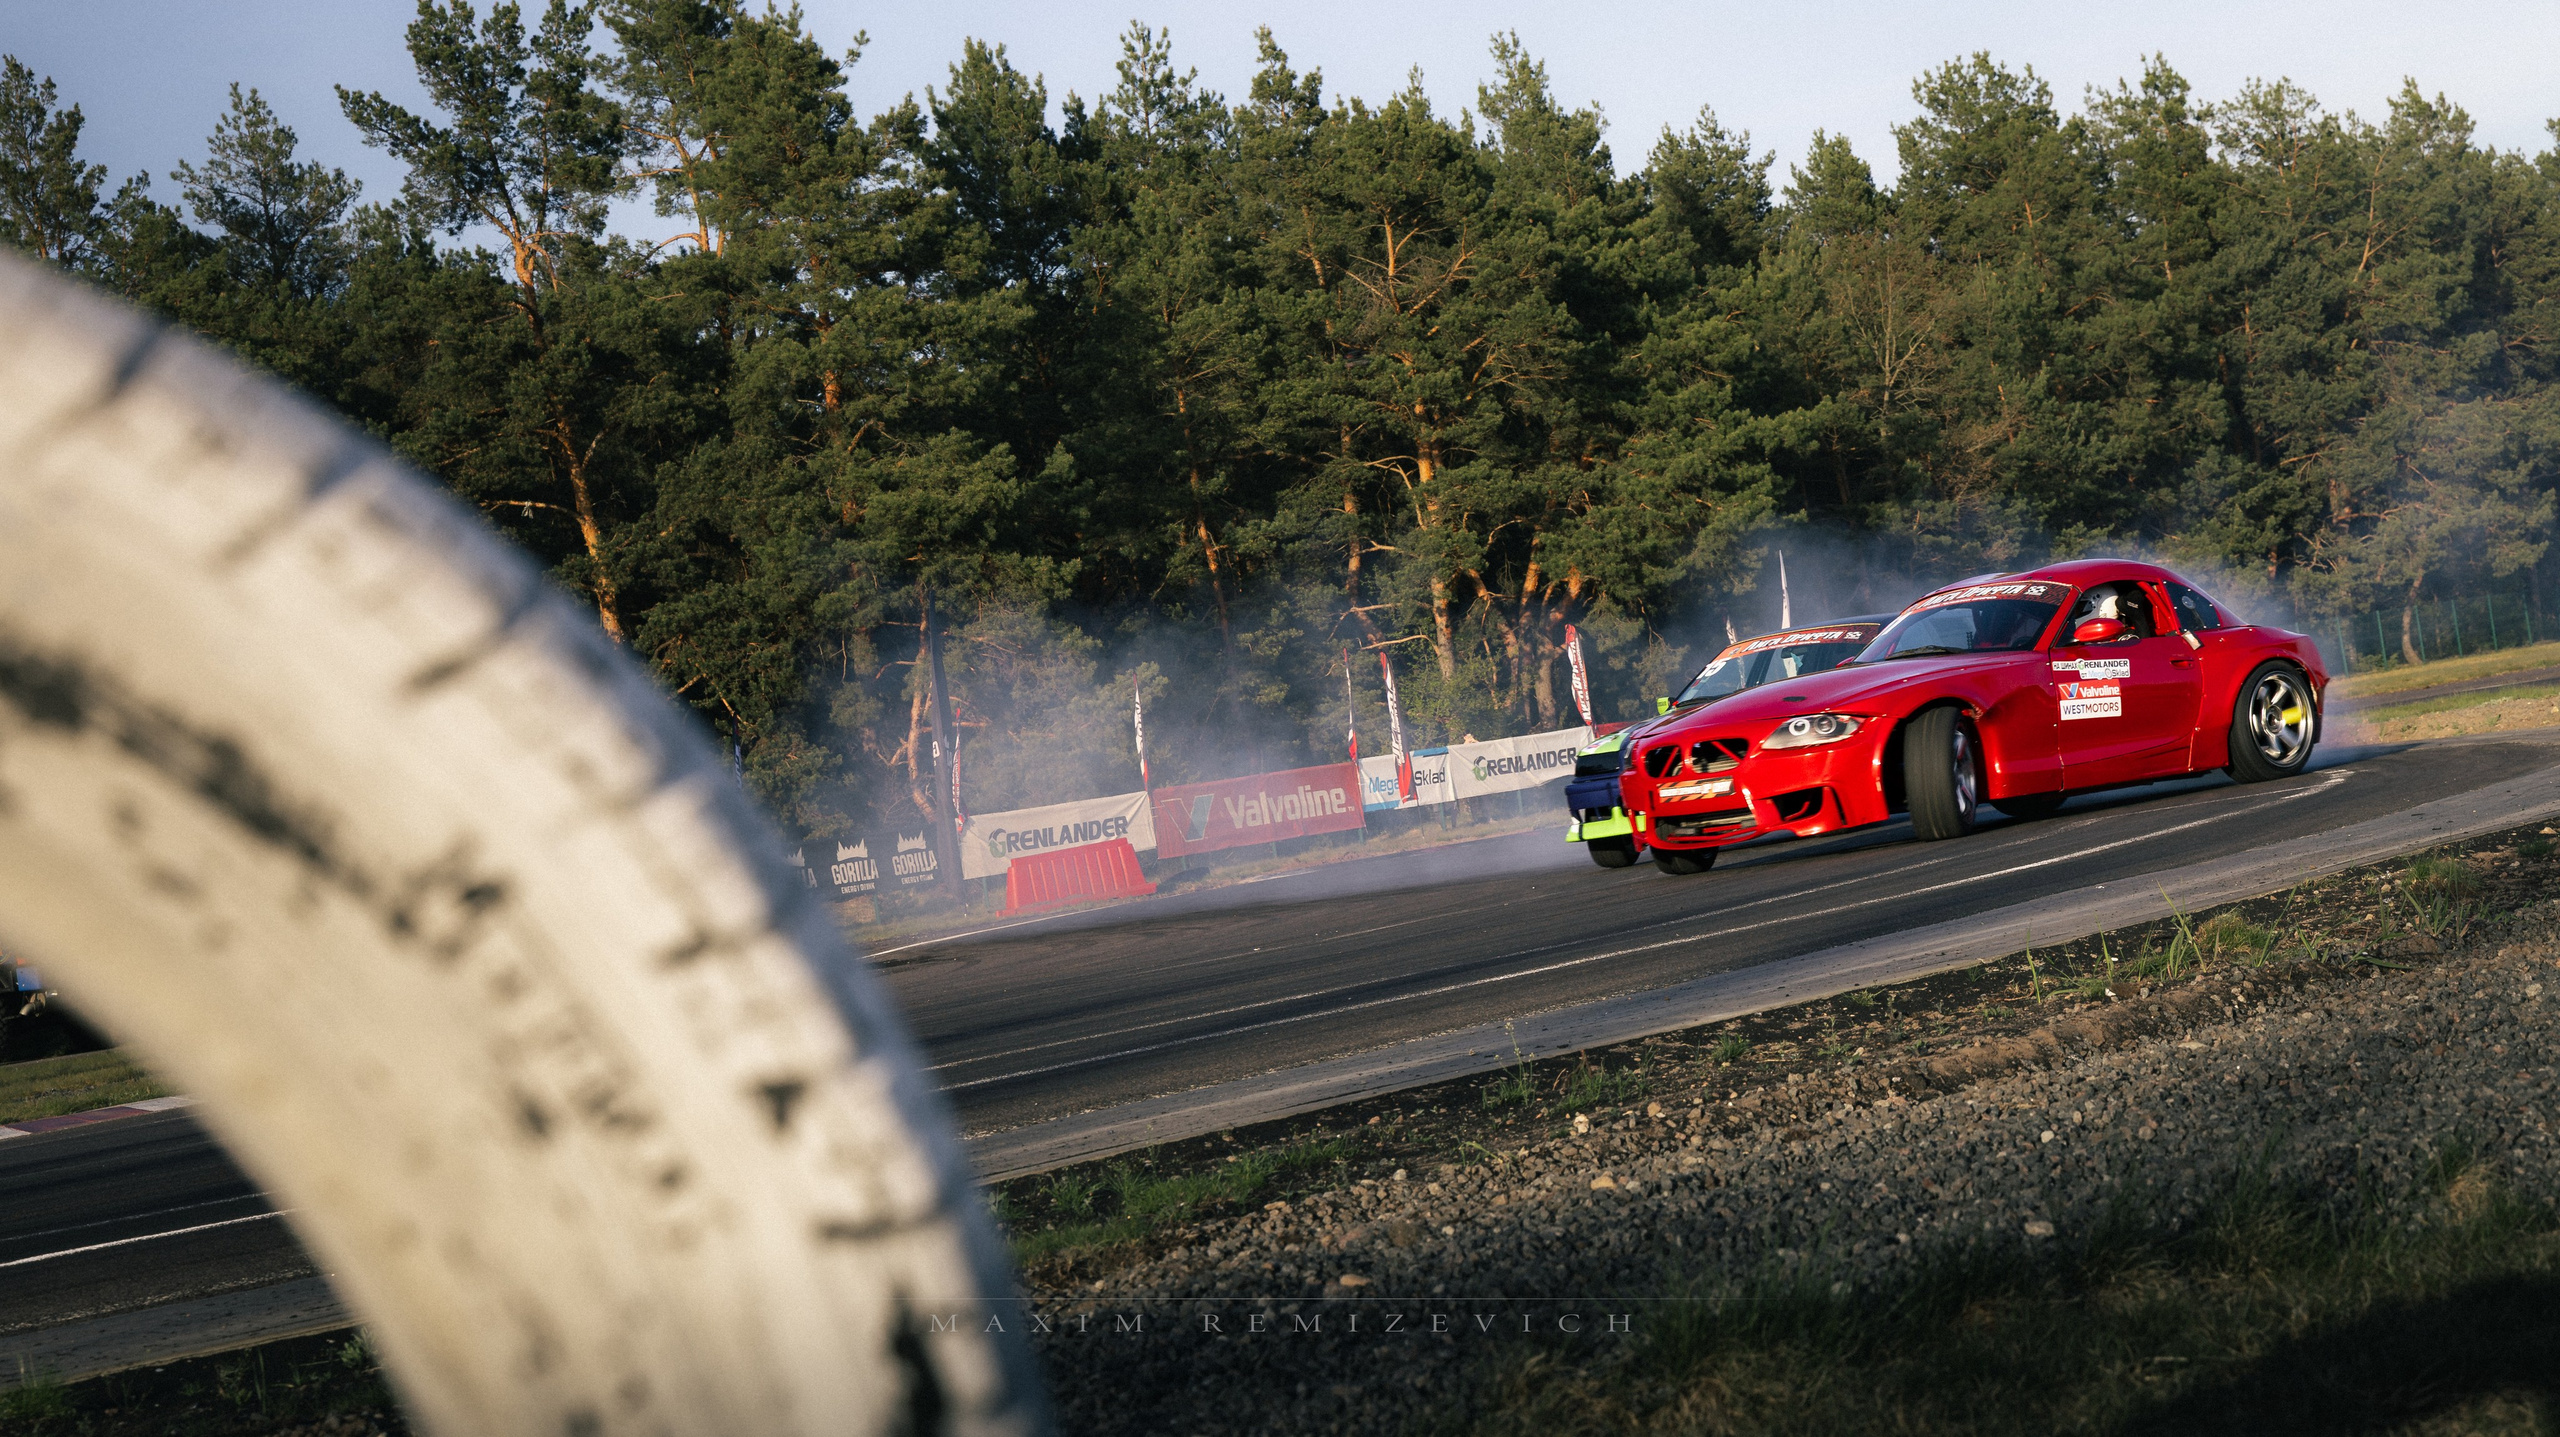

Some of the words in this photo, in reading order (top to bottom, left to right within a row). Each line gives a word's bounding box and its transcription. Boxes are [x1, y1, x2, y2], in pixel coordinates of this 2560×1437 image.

[1696, 657, 1731, 680] 15
[2079, 685, 2120, 698] Valvoline
[2063, 702, 2119, 715] WESTMOTORS
[1473, 747, 1577, 781] GRENLANDER
[1369, 776, 1399, 795] Mega
[1414, 767, 1446, 786] Sklad
[1224, 785, 1346, 829] Valvoline
[988, 815, 1128, 858] GRENLANDER
[831, 859, 879, 885] GORILLA
[892, 850, 938, 876] GORILLA
